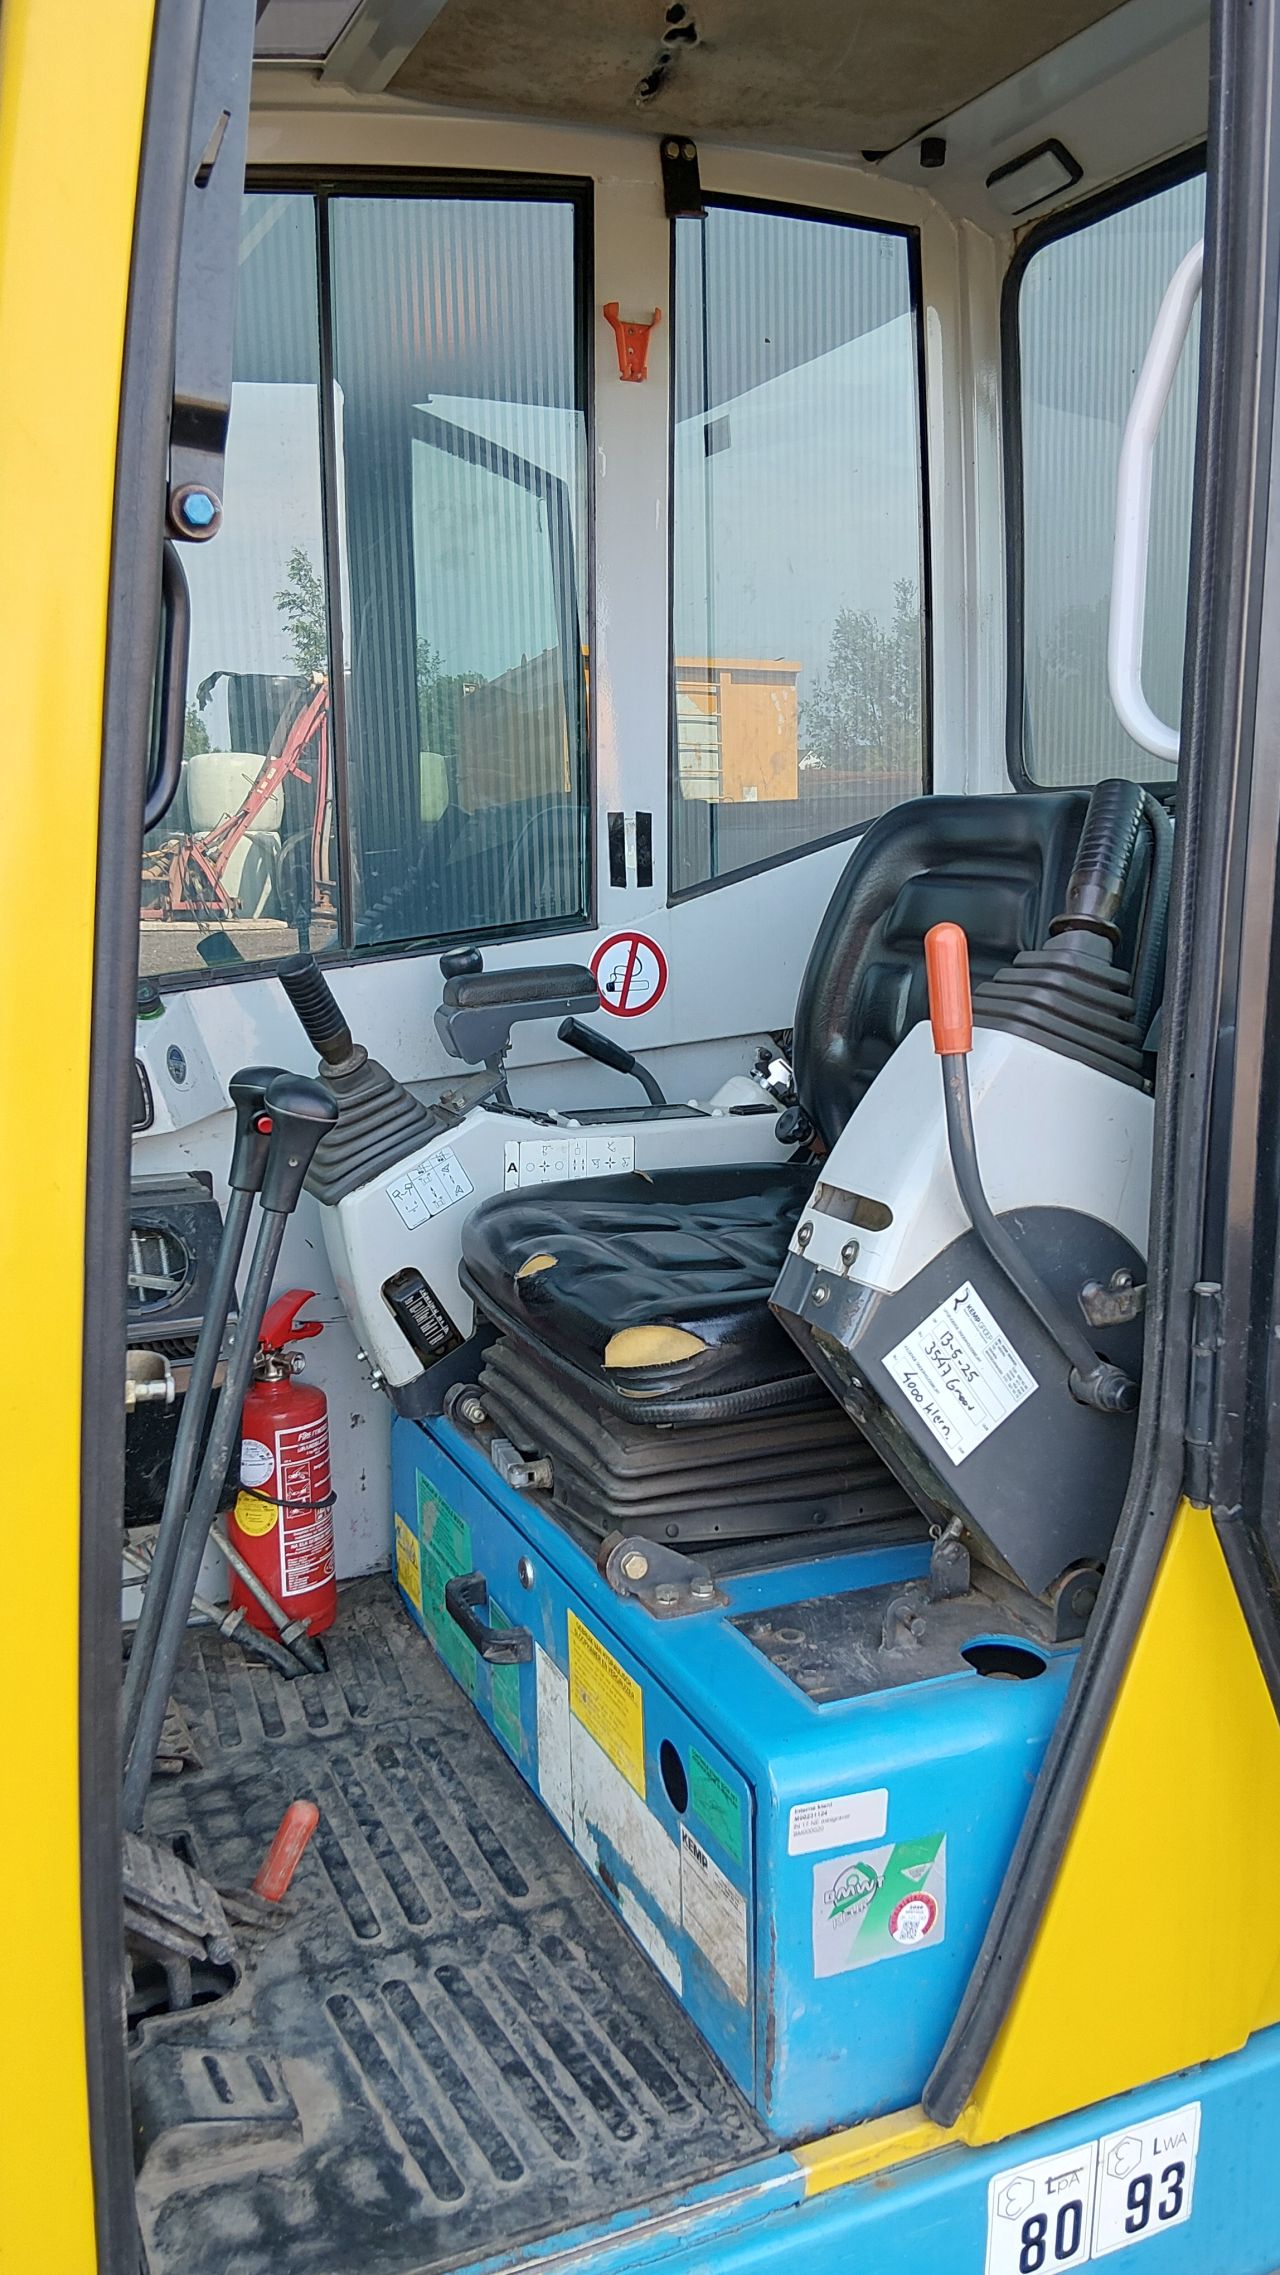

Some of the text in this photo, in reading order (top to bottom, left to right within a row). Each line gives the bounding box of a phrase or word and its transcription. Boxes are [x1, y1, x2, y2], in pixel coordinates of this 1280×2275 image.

[507, 1162, 518, 1173] A
[924, 1341, 953, 1377] 3547
[902, 1372, 924, 1404] 4000
[681, 1828, 709, 1872] KEMP
[1125, 2160, 1185, 2235] 93
[1019, 2199, 1083, 2275] 80
